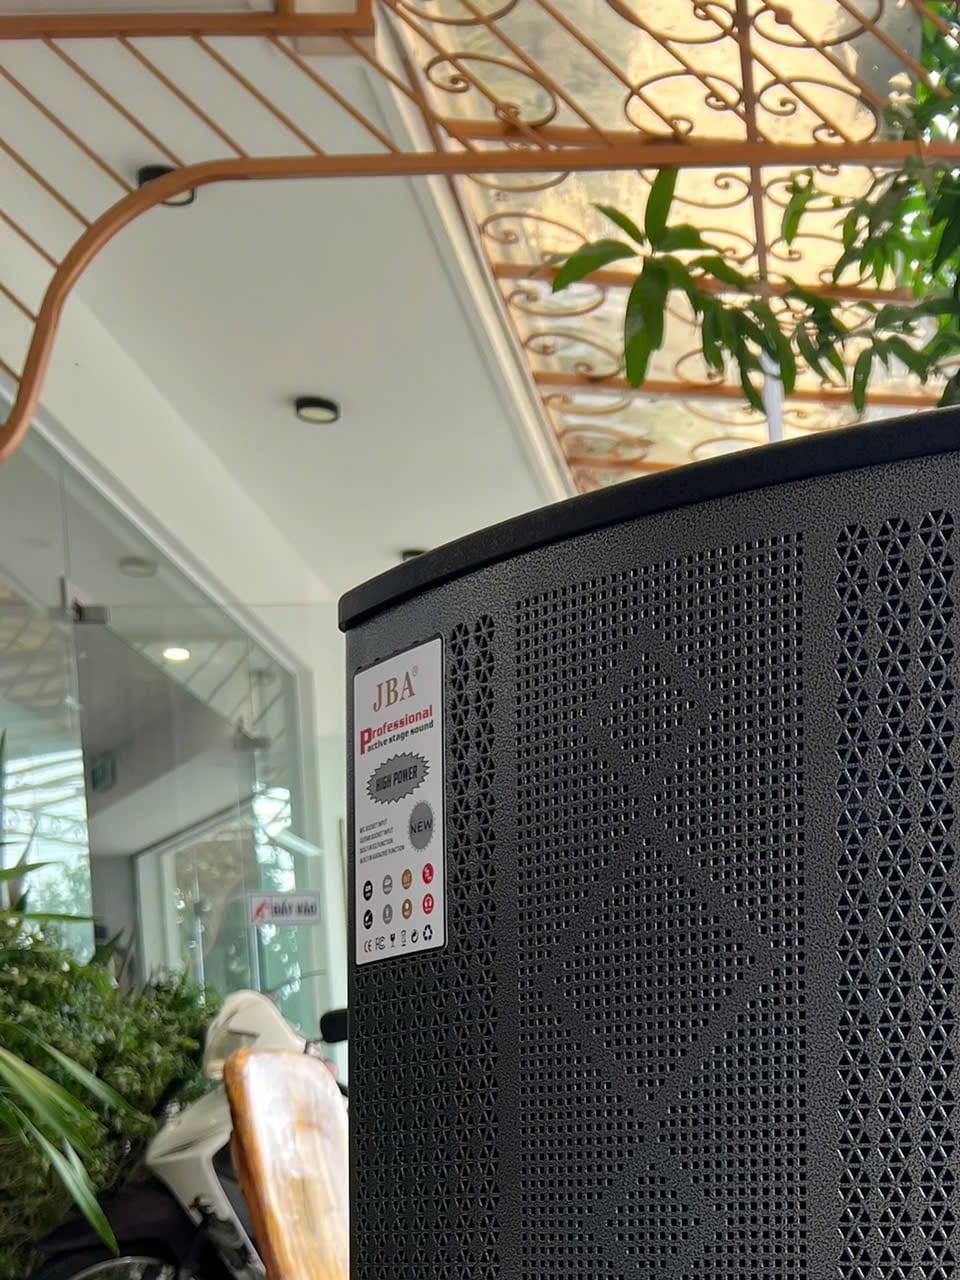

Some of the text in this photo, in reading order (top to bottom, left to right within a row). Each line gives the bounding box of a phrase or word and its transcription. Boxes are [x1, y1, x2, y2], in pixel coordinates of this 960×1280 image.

[373, 671, 416, 712] JBA
[360, 704, 433, 755] Professional
[367, 719, 434, 753] active stage sound
[392, 765, 418, 787] POWER
[410, 819, 433, 834] NEW
